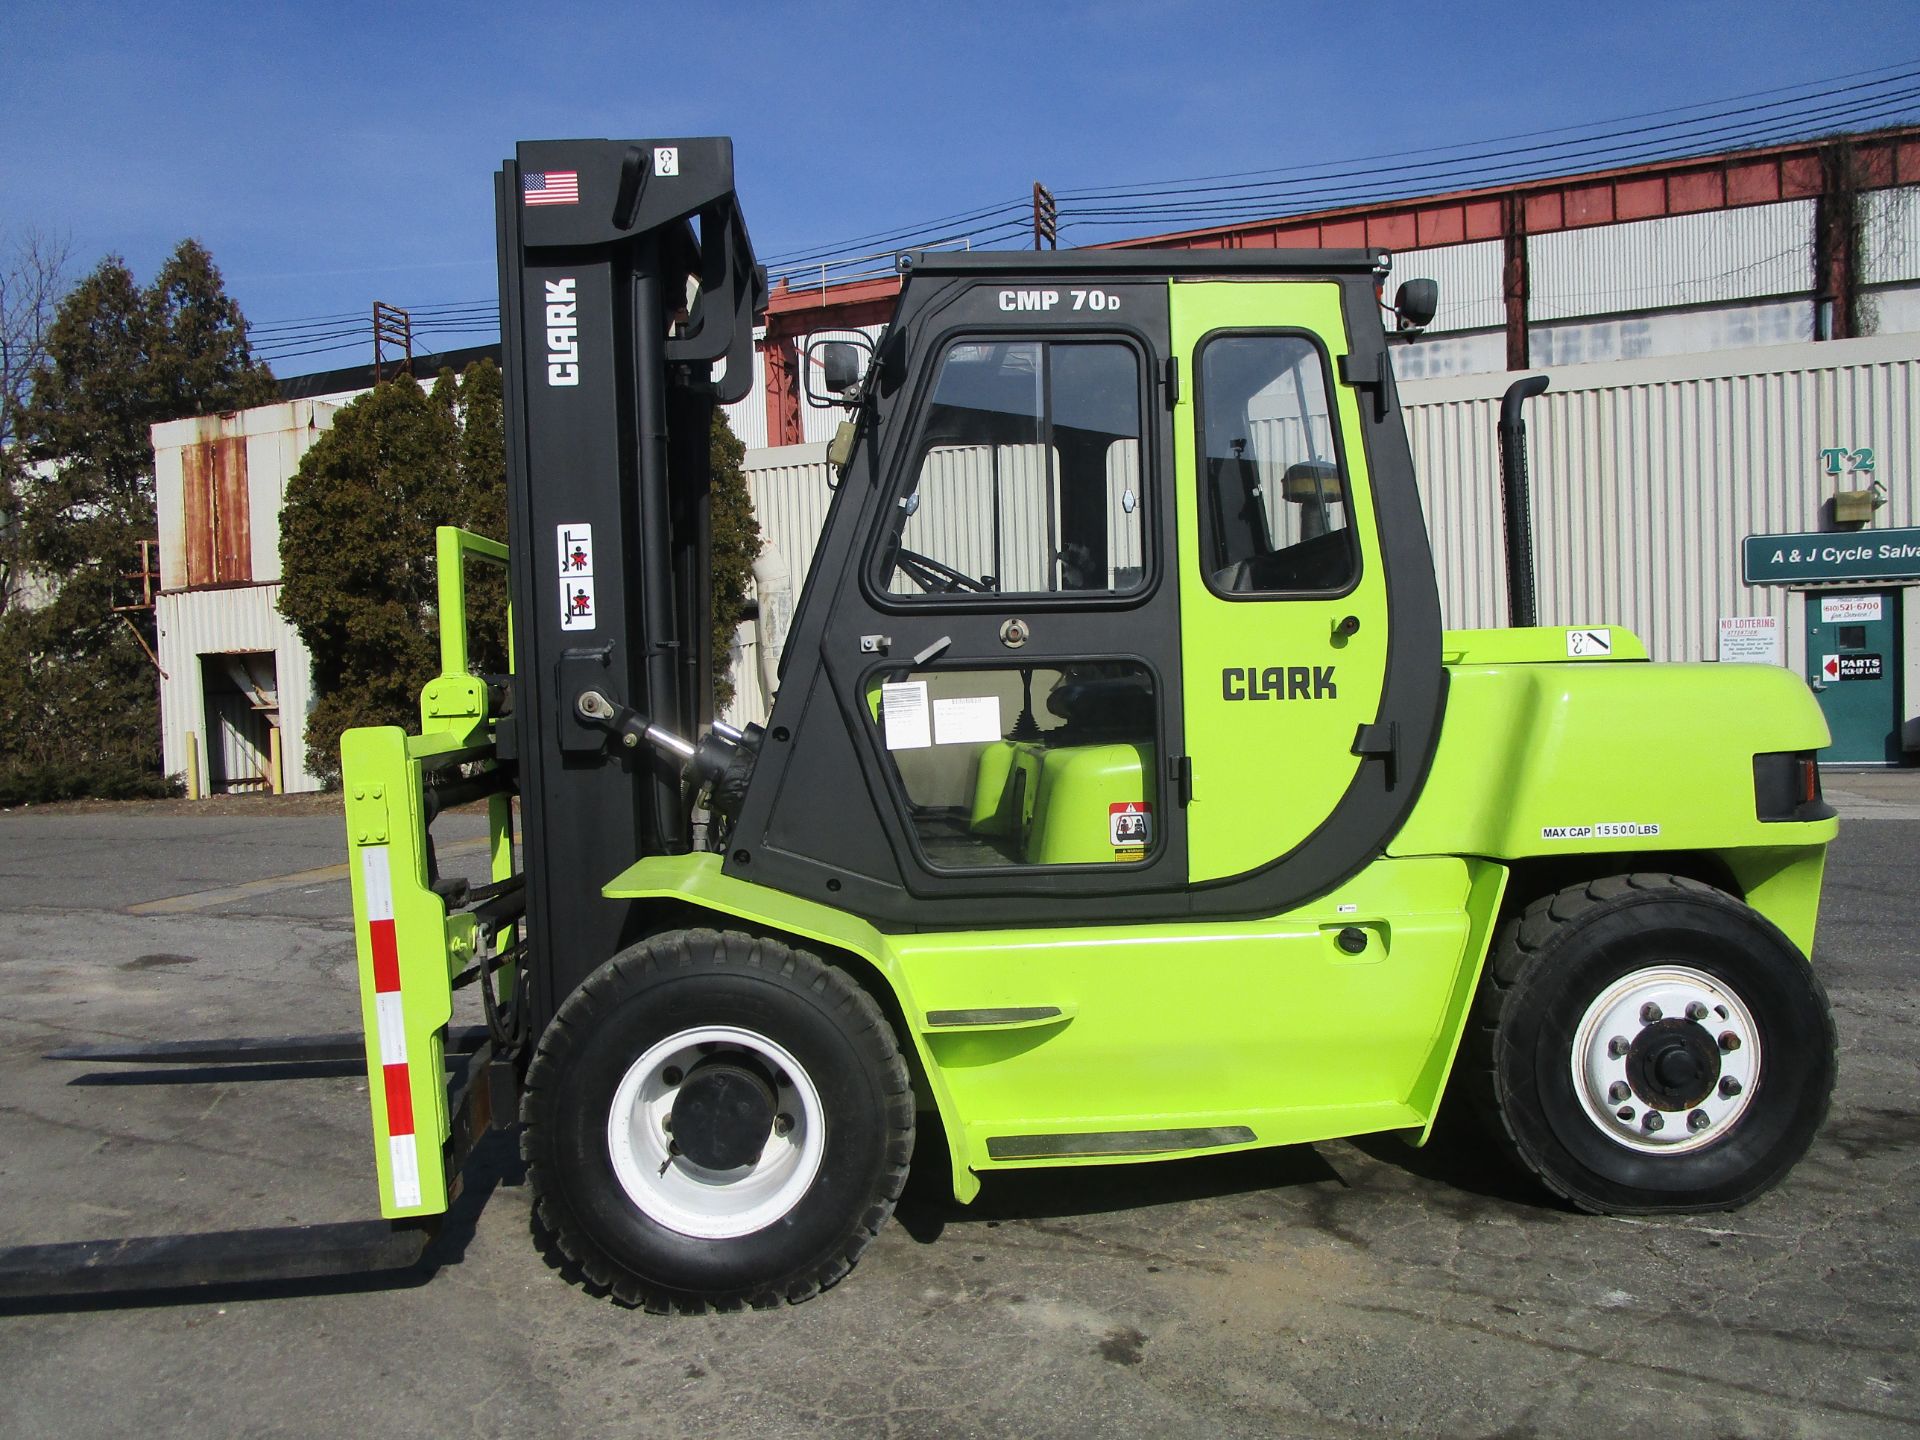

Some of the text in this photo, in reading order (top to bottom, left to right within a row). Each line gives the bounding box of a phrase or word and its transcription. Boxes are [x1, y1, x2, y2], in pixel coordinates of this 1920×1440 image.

[999, 290, 1059, 311] CMP
[545, 278, 579, 386] CLARK
[1820, 448, 1876, 473] T2
[1771, 550, 1784, 564] A
[1789, 549, 1801, 563] &
[1806, 548, 1817, 562] J
[1822, 547, 1873, 564] Cycle
[1721, 618, 1775, 629] NO LOITERING
[1841, 659, 1880, 667] PARTS
[1222, 666, 1337, 701] CLARK
[1543, 825, 1658, 837] MAX CAP 15500 LBS
